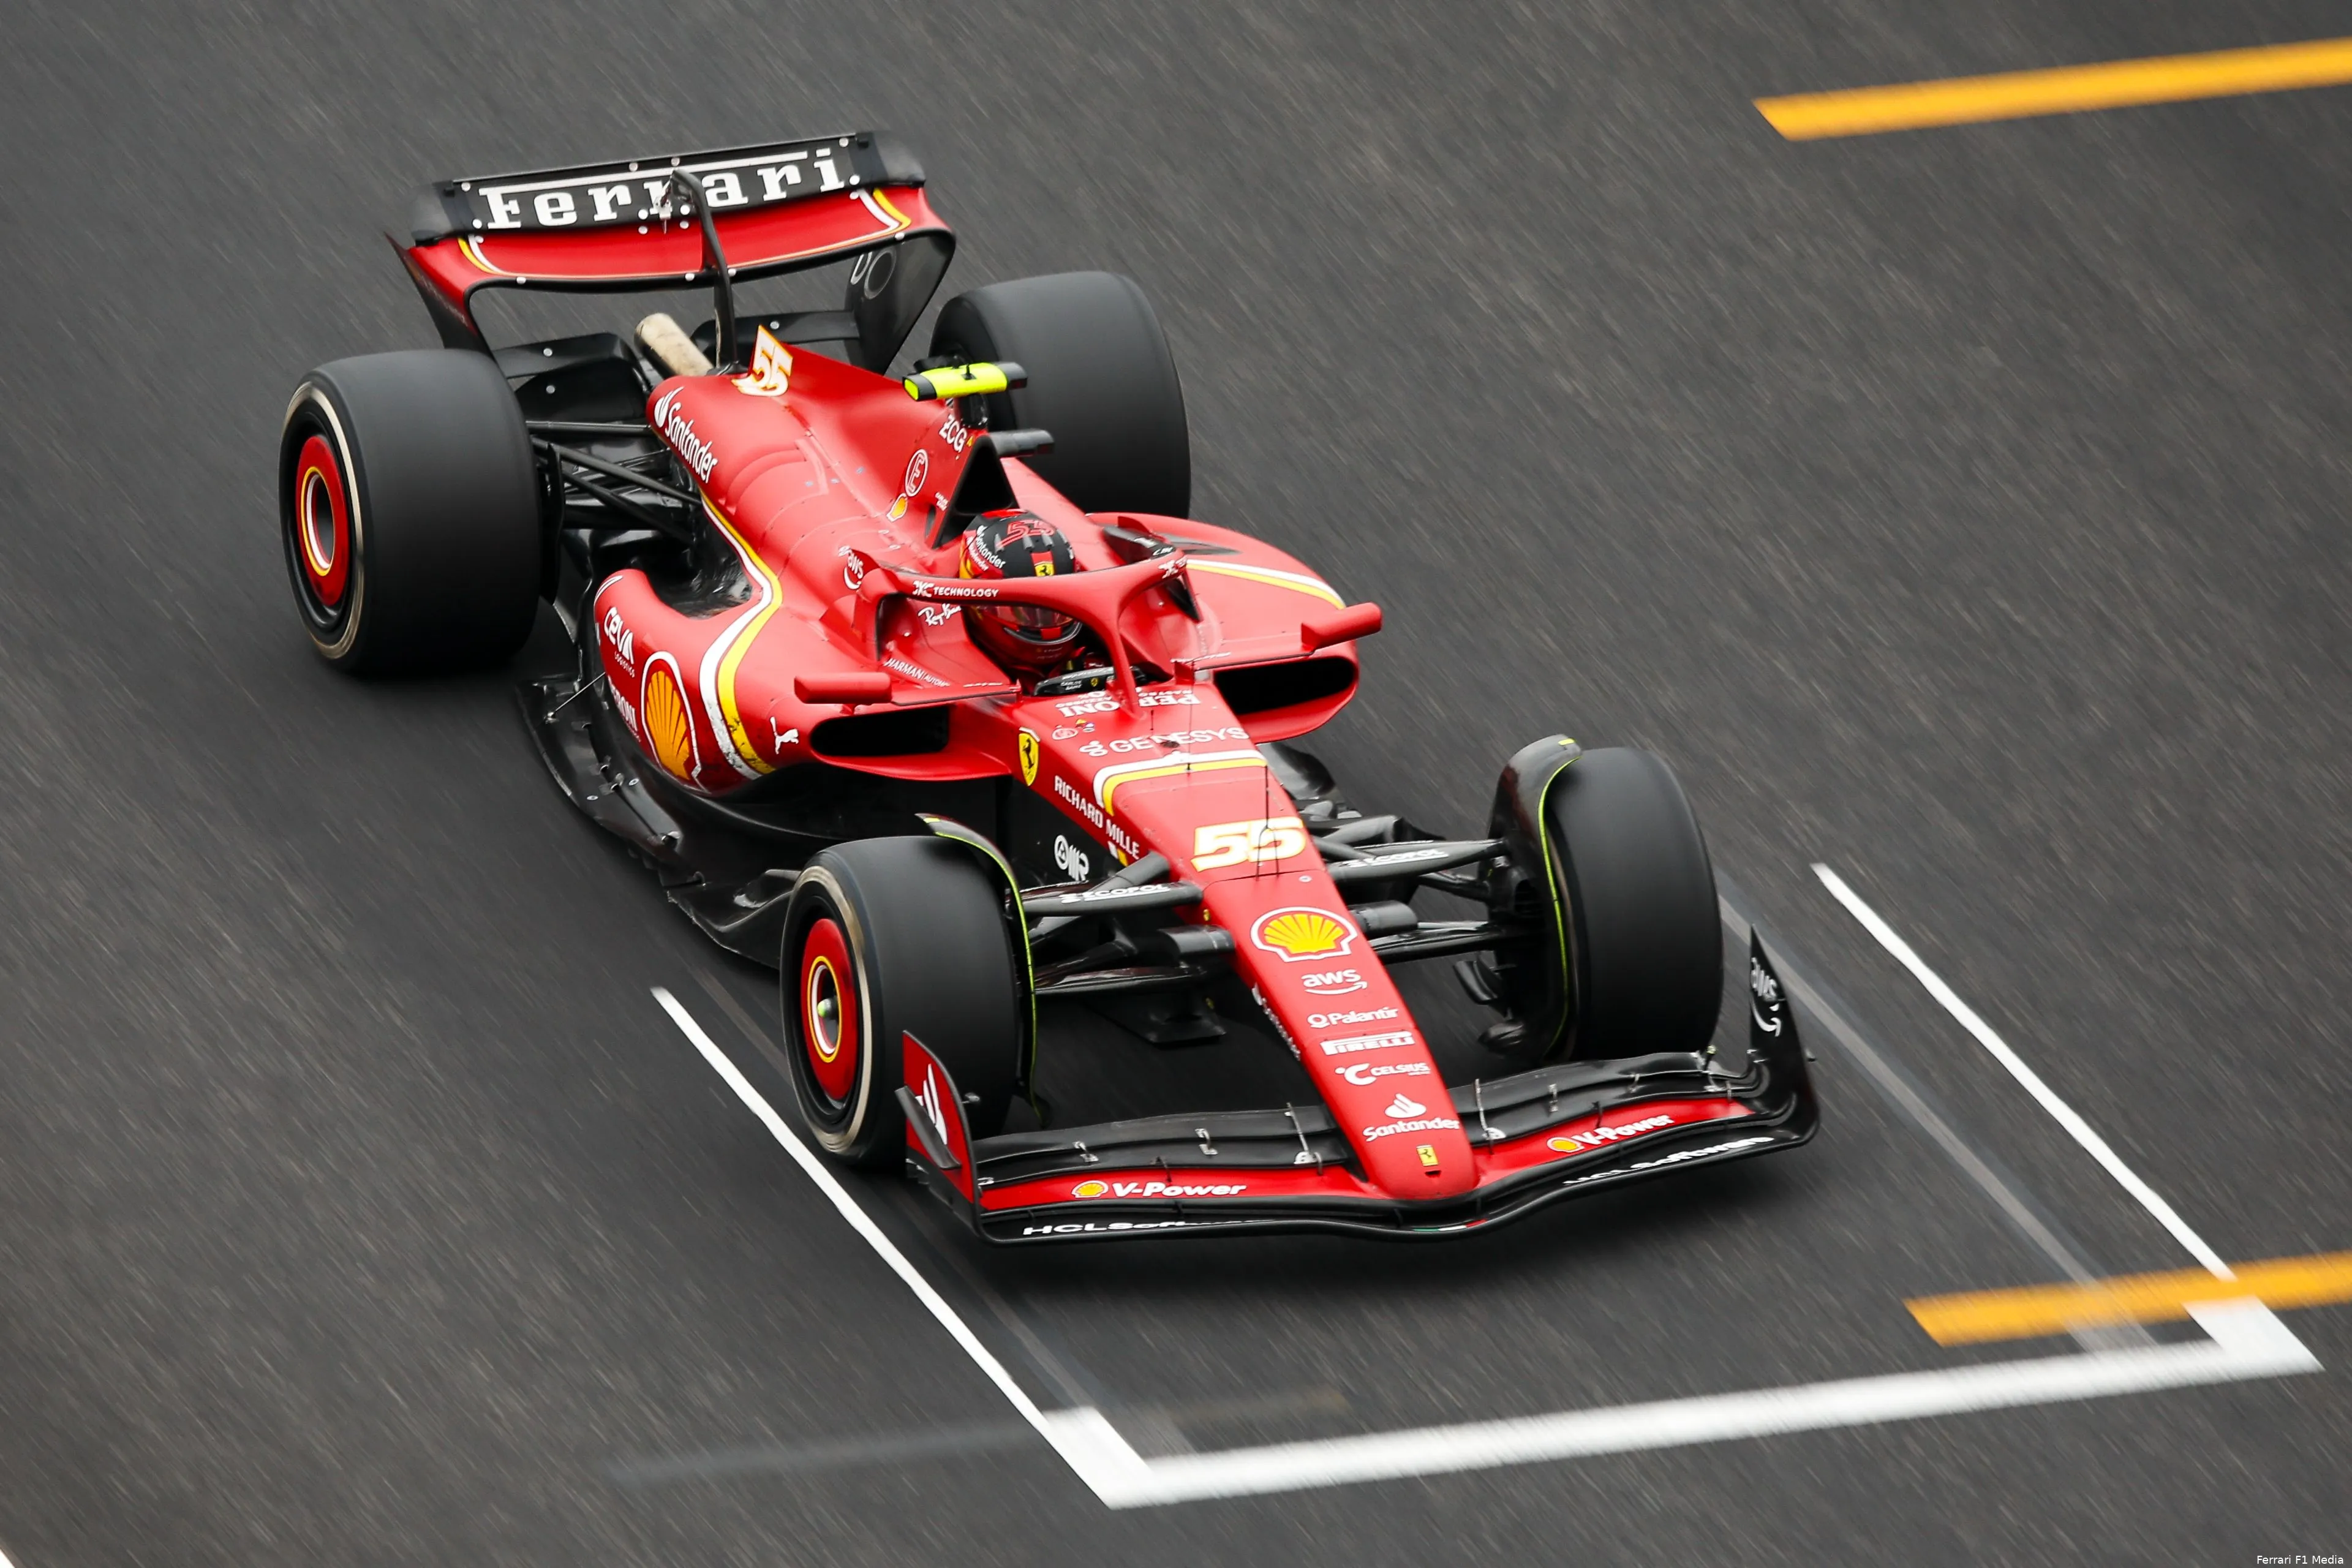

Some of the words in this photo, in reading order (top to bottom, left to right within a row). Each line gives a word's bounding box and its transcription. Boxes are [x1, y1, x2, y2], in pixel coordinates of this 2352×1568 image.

[478, 147, 846, 229] Ferrari
[731, 325, 793, 397] 55
[665, 402, 718, 483] Santander
[933, 586, 999, 597] TECHNOLOGY
[883, 658, 924, 680] HARMAN
[1109, 726, 1250, 753] GENESYS
[1055, 775, 1103, 828] RICHARD
[1106, 819, 1139, 859] MILLE
[1191, 817, 1307, 872] 55
[1301, 969, 1361, 987] aws
[1327, 1007, 1398, 1025] Palantir
[1320, 1030, 1415, 1055] PIRELLI
[1363, 1117, 1460, 1142] Santander
[1572, 1114, 1675, 1145] V-Power
[1113, 1181, 1246, 1197] V-Power
